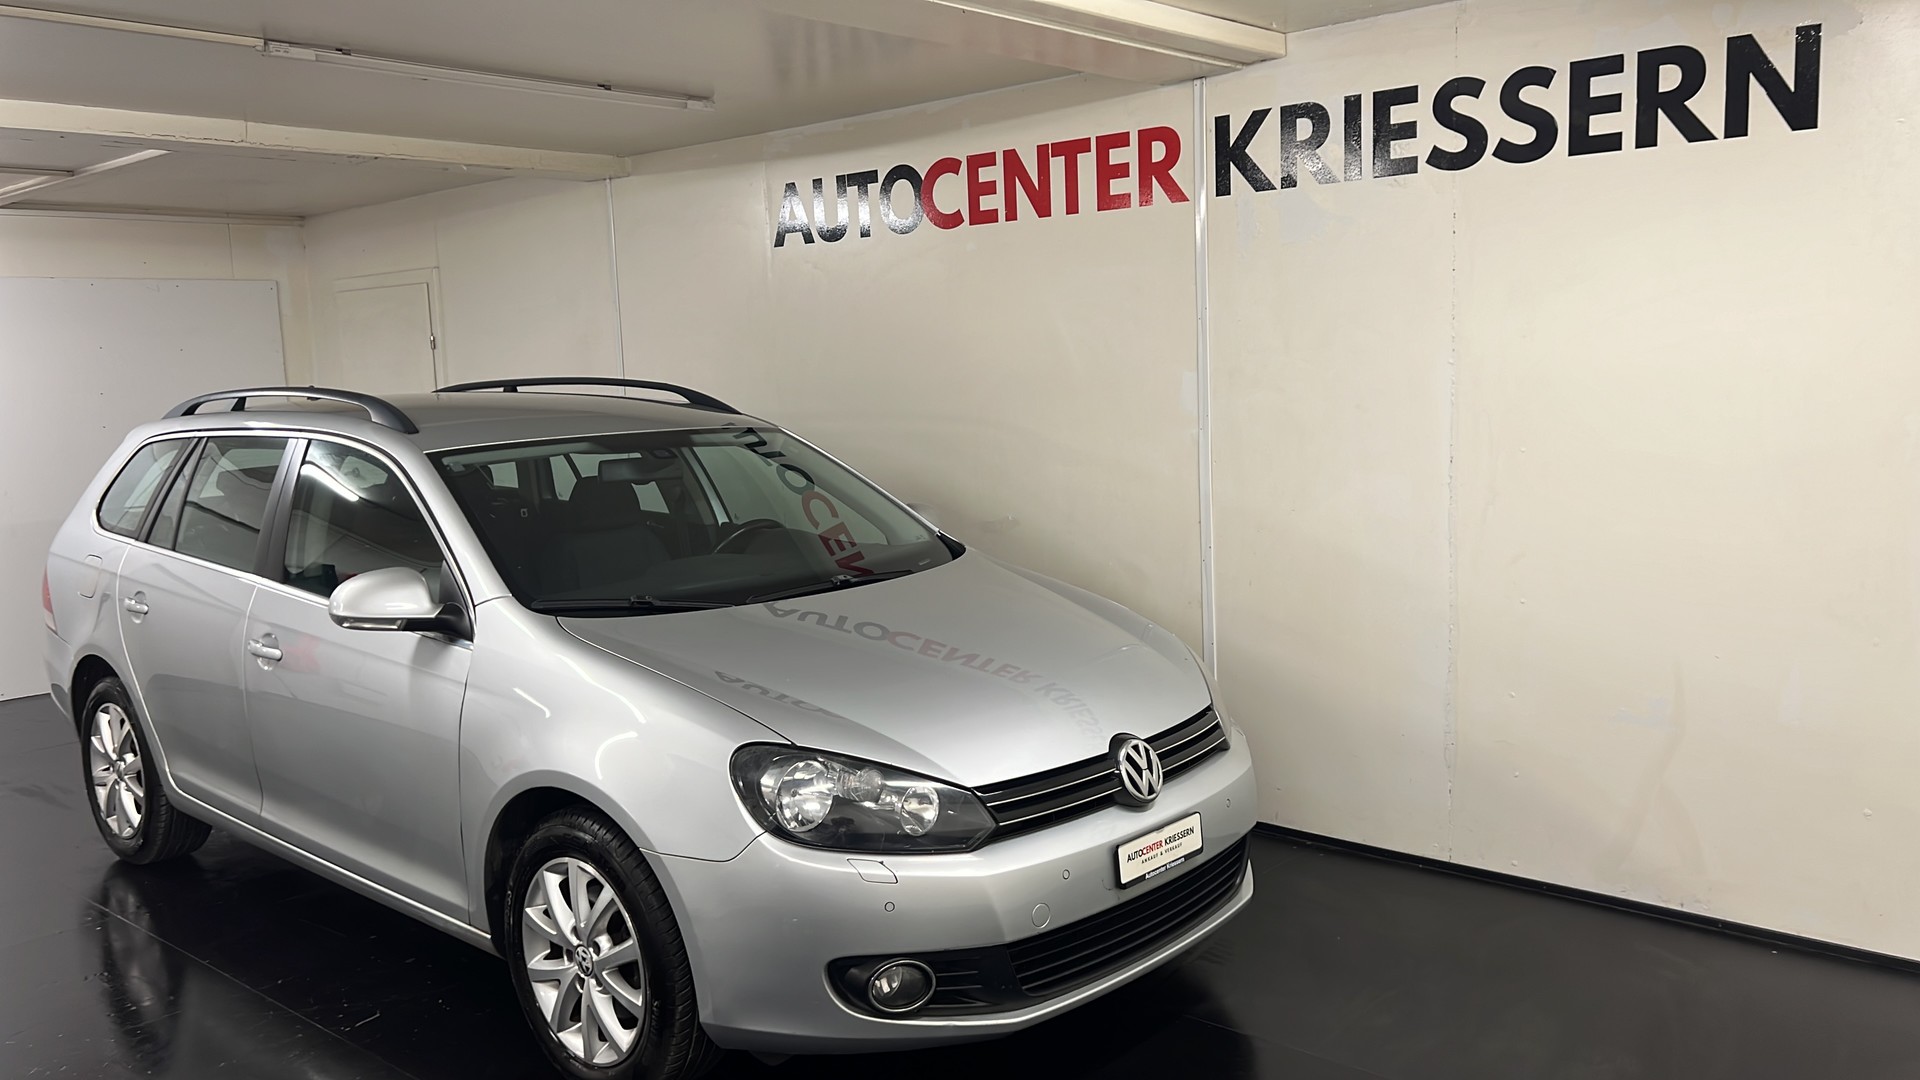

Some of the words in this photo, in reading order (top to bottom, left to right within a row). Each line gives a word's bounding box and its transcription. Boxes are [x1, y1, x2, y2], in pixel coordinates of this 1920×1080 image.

[773, 125, 1190, 248] AUTOCENTER
[1213, 22, 1823, 197] KRIESSERN
[1126, 840, 1163, 863] AUTOCENTER
[1164, 826, 1195, 847] KRIESSERN
[1145, 865, 1167, 880] Autocenter
